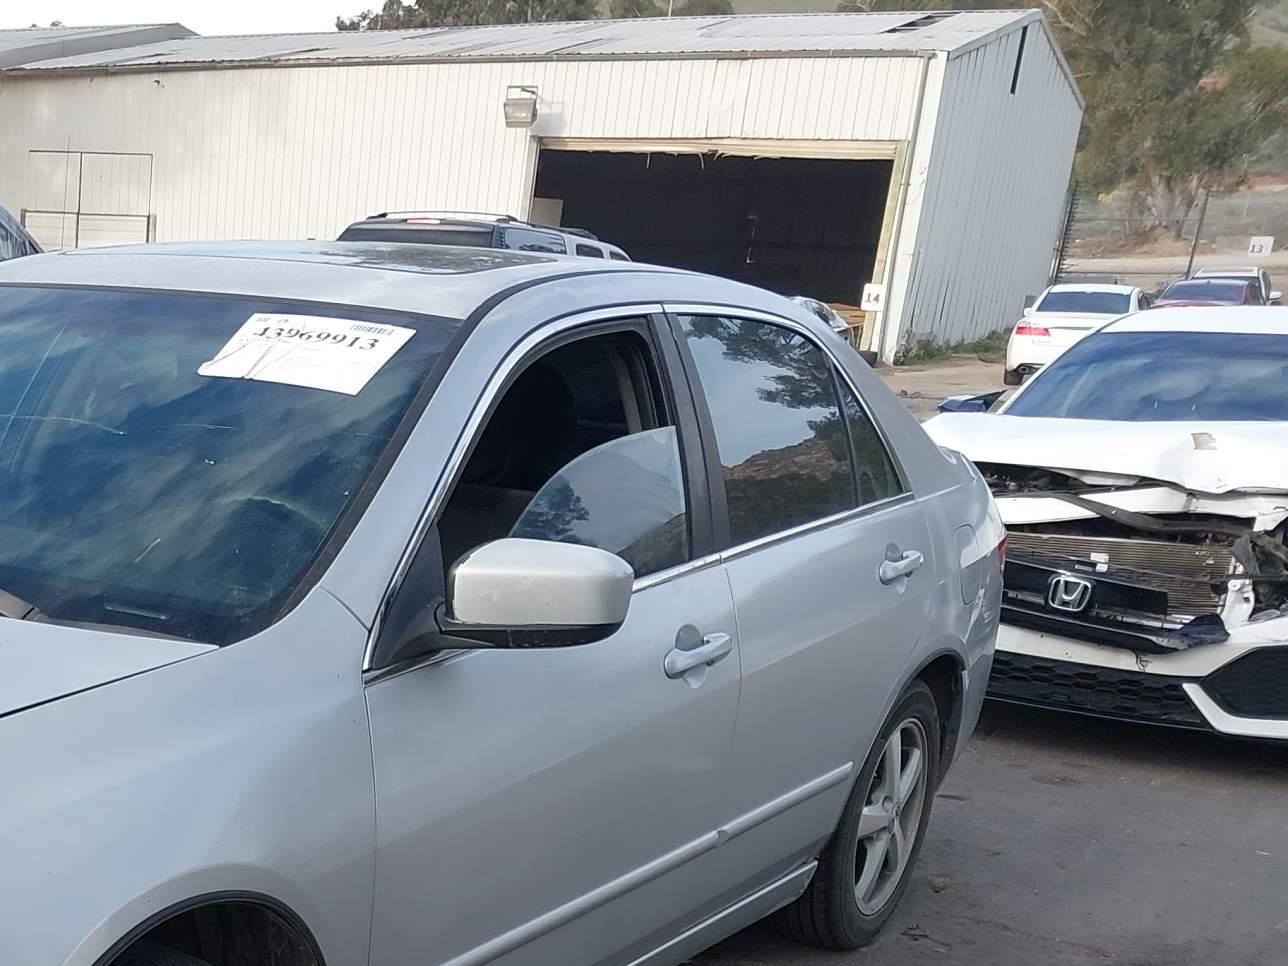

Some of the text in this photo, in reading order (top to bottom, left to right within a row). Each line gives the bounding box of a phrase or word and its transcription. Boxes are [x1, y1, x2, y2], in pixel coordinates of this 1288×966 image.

[1250, 244, 1263, 253] 13
[865, 292, 880, 304] 14
[253, 326, 380, 350] 43969913
